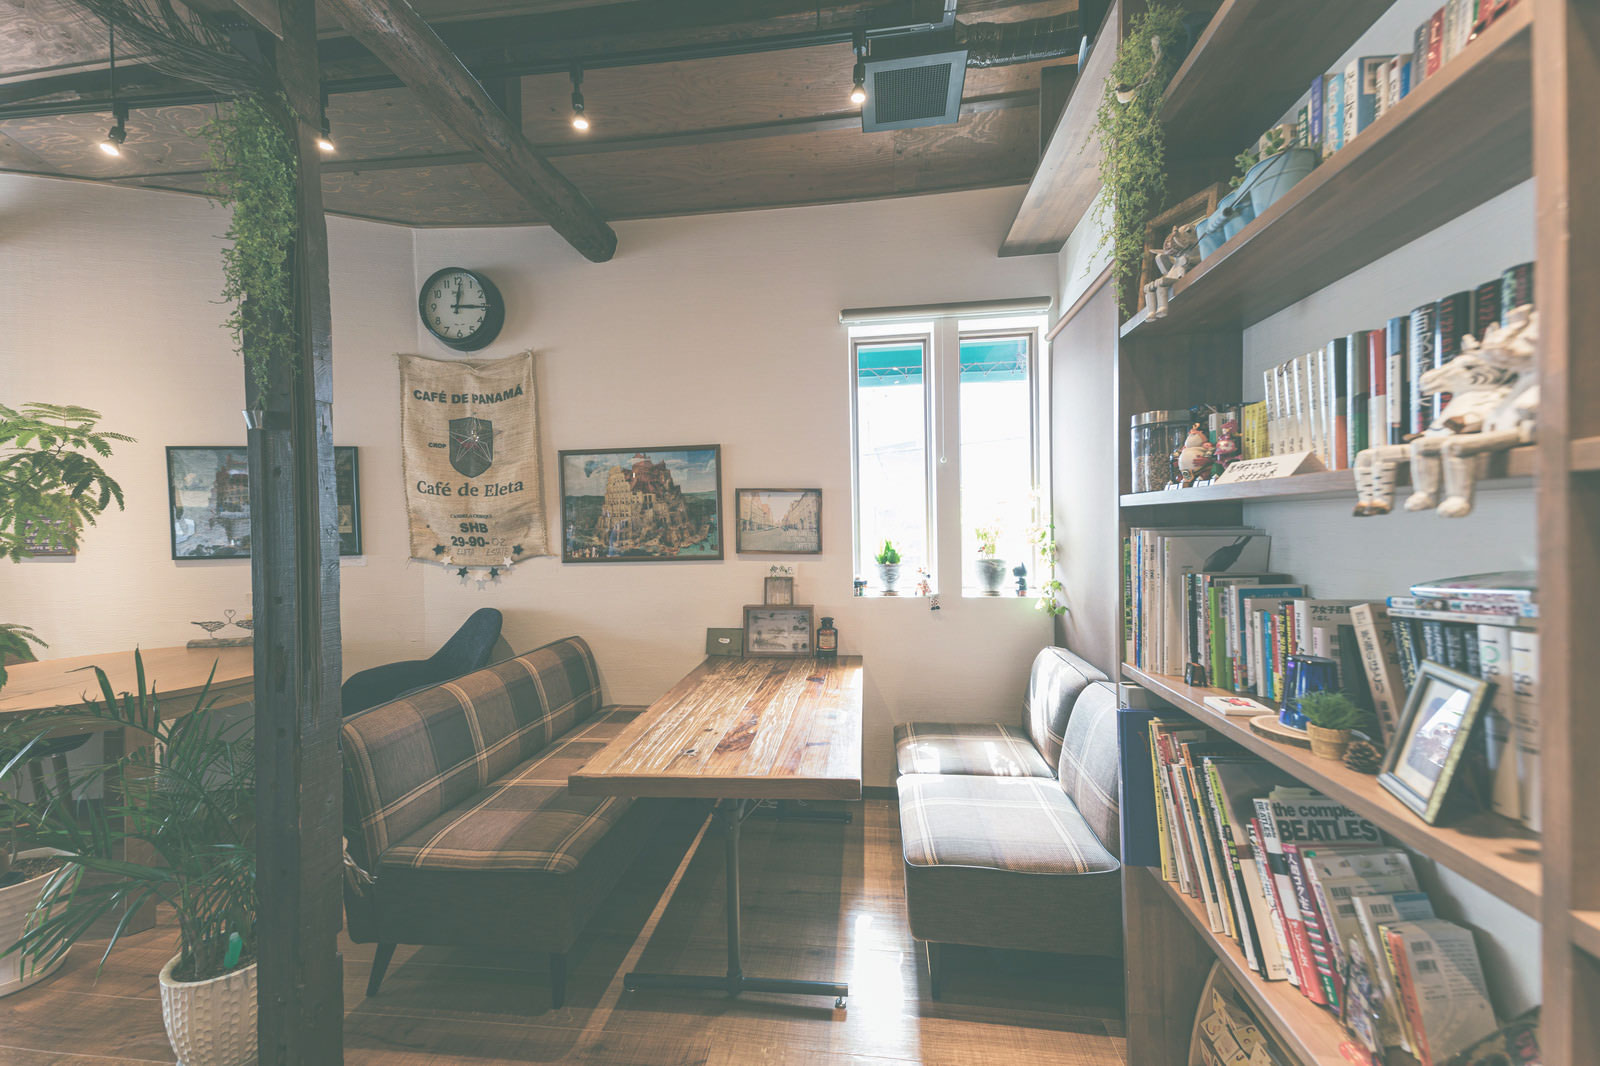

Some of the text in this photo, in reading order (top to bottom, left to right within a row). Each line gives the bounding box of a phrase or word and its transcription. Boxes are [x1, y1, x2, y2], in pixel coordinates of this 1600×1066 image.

[443, 280, 450, 289] 11
[454, 276, 463, 286] 12
[434, 289, 442, 299] 10
[477, 289, 484, 299] 2
[431, 303, 437, 312] 9
[435, 316, 441, 326] 8
[443, 326, 450, 335] 7
[456, 329, 464, 338] 6
[469, 325, 476, 335] 5
[413, 383, 524, 405] CAFÉ DE PANAMÁ
[416, 480, 524, 497] Café de Eleta
[459, 522, 489, 533] SHB
[1272, 802, 1361, 821] the comple
[1280, 820, 1379, 842] BEATLES
